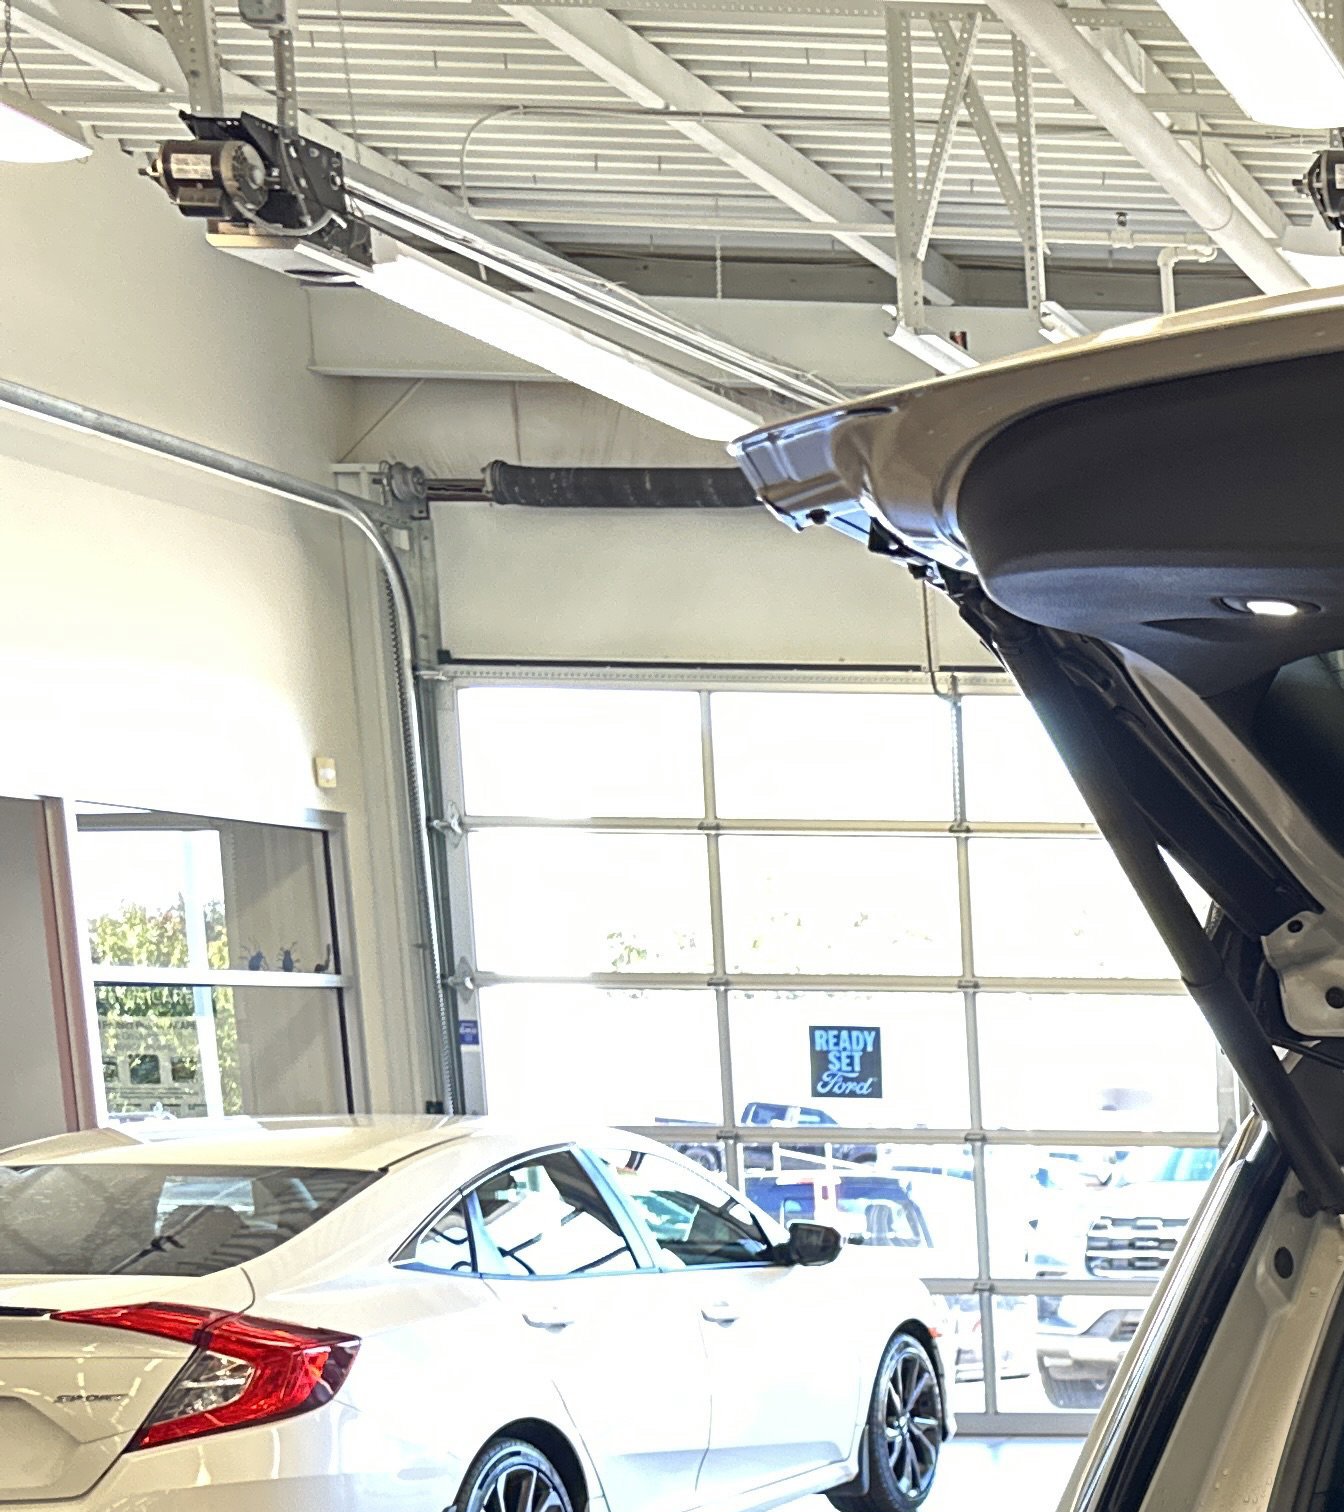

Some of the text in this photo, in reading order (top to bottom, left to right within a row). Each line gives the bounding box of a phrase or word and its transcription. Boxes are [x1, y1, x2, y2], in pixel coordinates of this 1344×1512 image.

[814, 1029, 876, 1052] READY
[828, 1051, 863, 1071] SET
[816, 1070, 873, 1095] Ford
